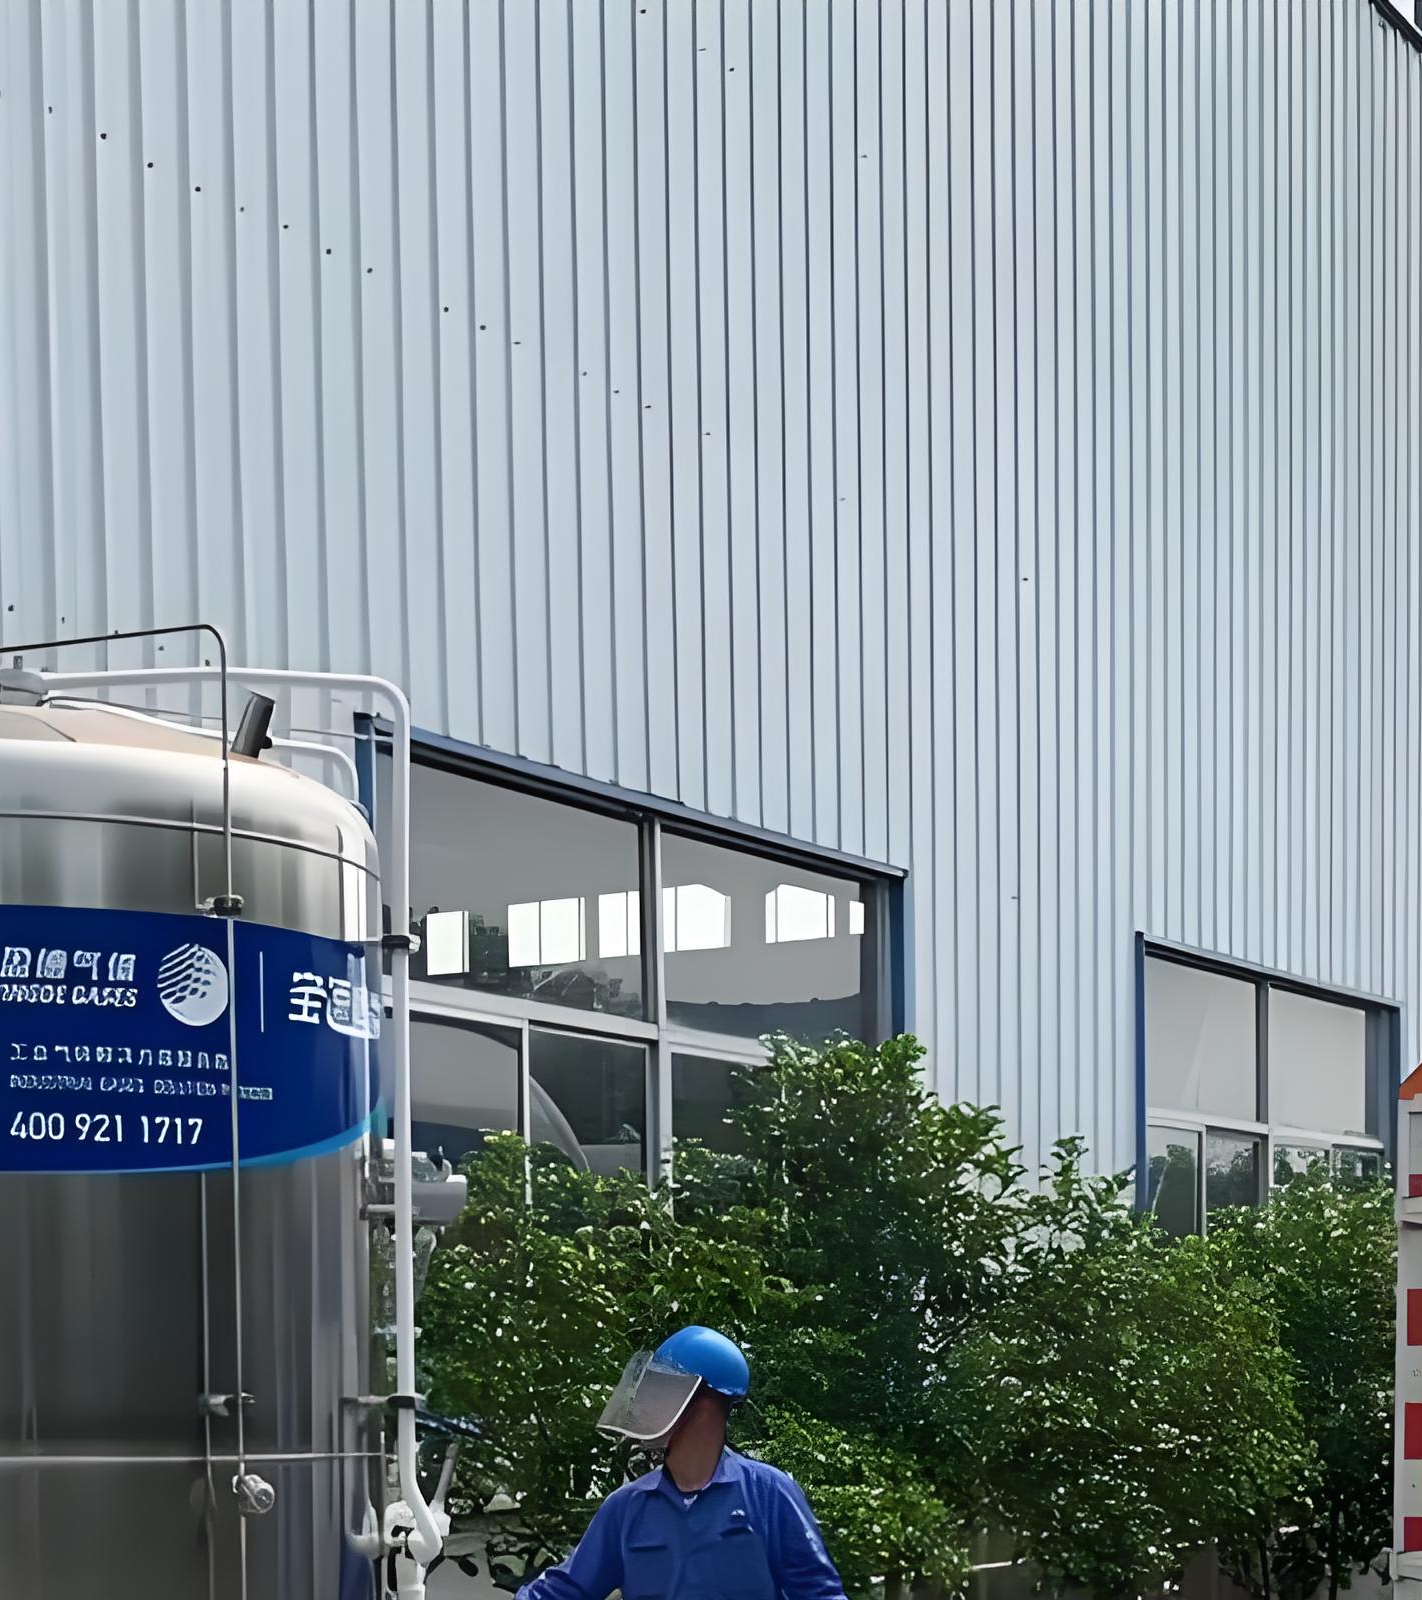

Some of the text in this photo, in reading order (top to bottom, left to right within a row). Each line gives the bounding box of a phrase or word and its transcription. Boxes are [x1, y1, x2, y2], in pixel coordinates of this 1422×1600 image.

[10, 1111, 203, 1145] 400 921 1717
